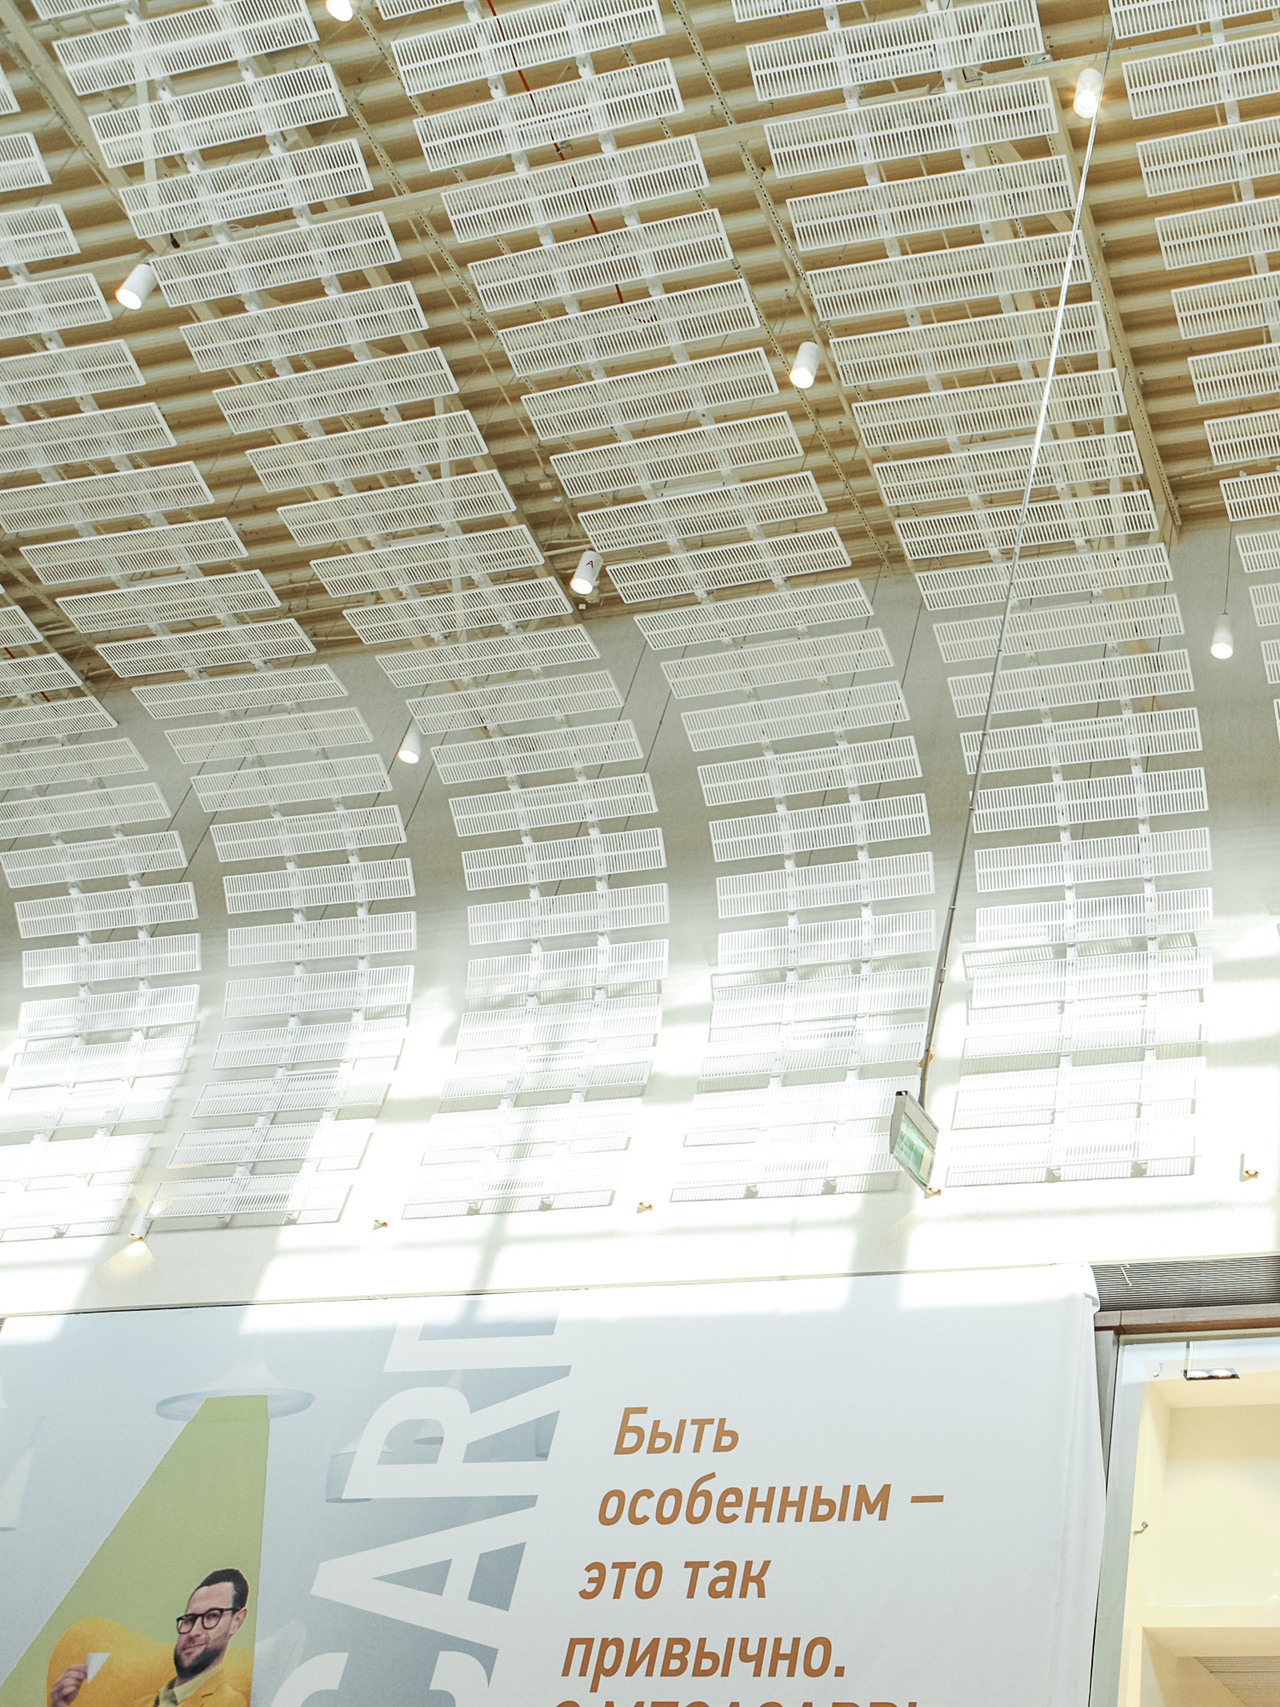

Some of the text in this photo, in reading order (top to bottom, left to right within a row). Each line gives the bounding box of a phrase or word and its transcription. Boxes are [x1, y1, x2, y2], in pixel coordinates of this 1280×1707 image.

[613, 1406, 740, 1456] Быть
[598, 1471, 892, 1526] особенным
[578, 1559, 772, 1600] это так
[561, 1636, 846, 1693] привычно.
